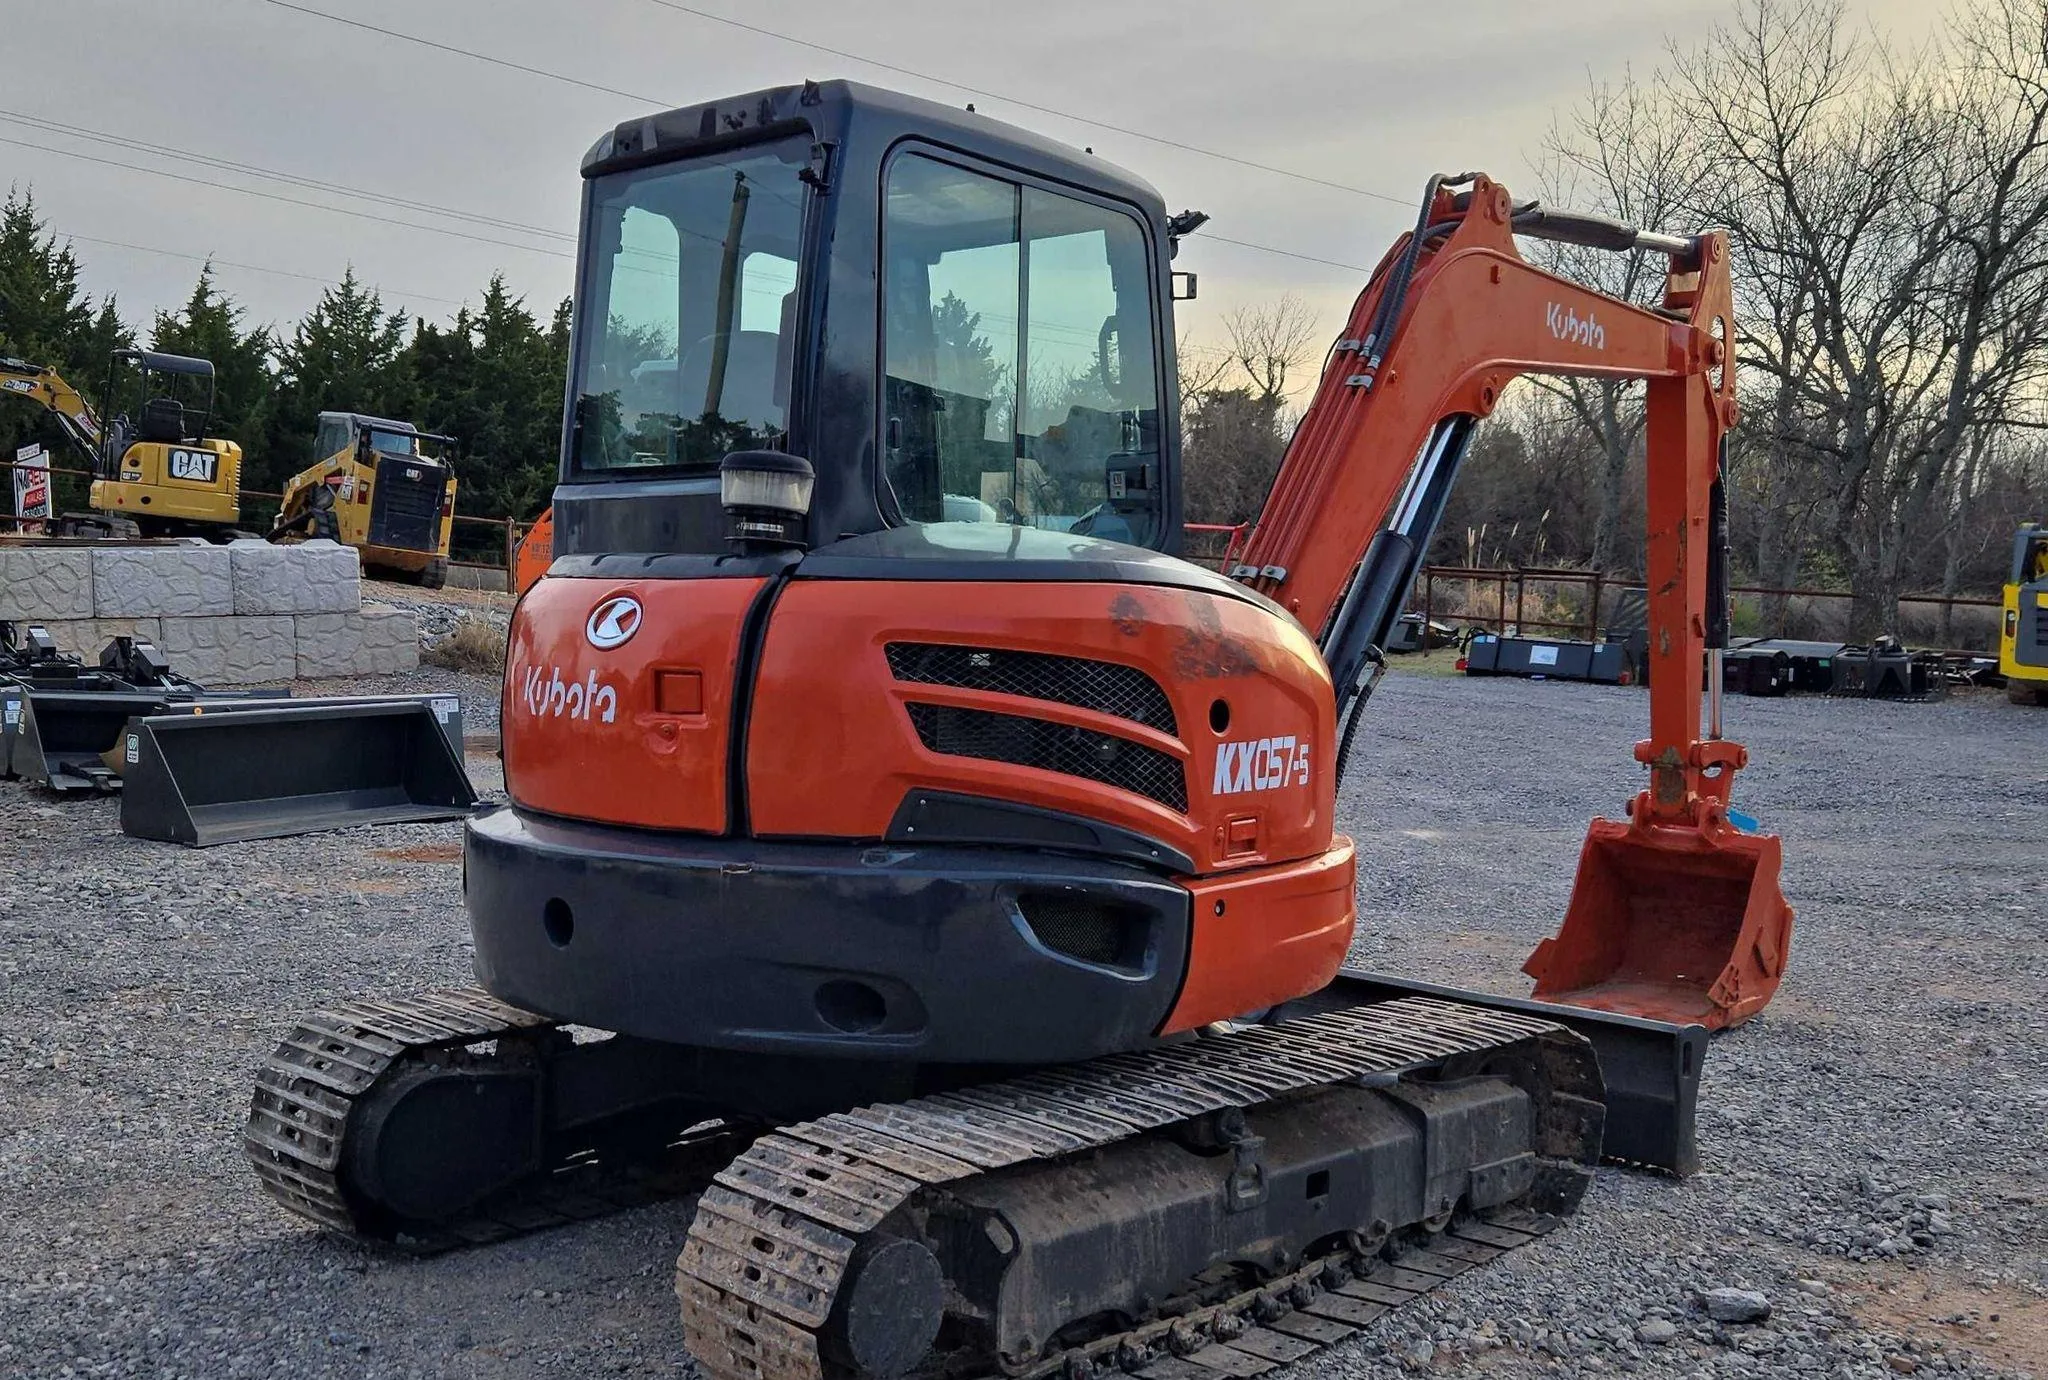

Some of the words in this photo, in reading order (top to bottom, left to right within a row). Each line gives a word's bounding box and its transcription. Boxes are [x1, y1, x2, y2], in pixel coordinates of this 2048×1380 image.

[1546, 301, 1605, 350] Kubota
[172, 450, 215, 481] CAT
[405, 468, 419, 478] CAT
[524, 666, 616, 723] Kubota
[1212, 735, 1309, 795] KX057-5
